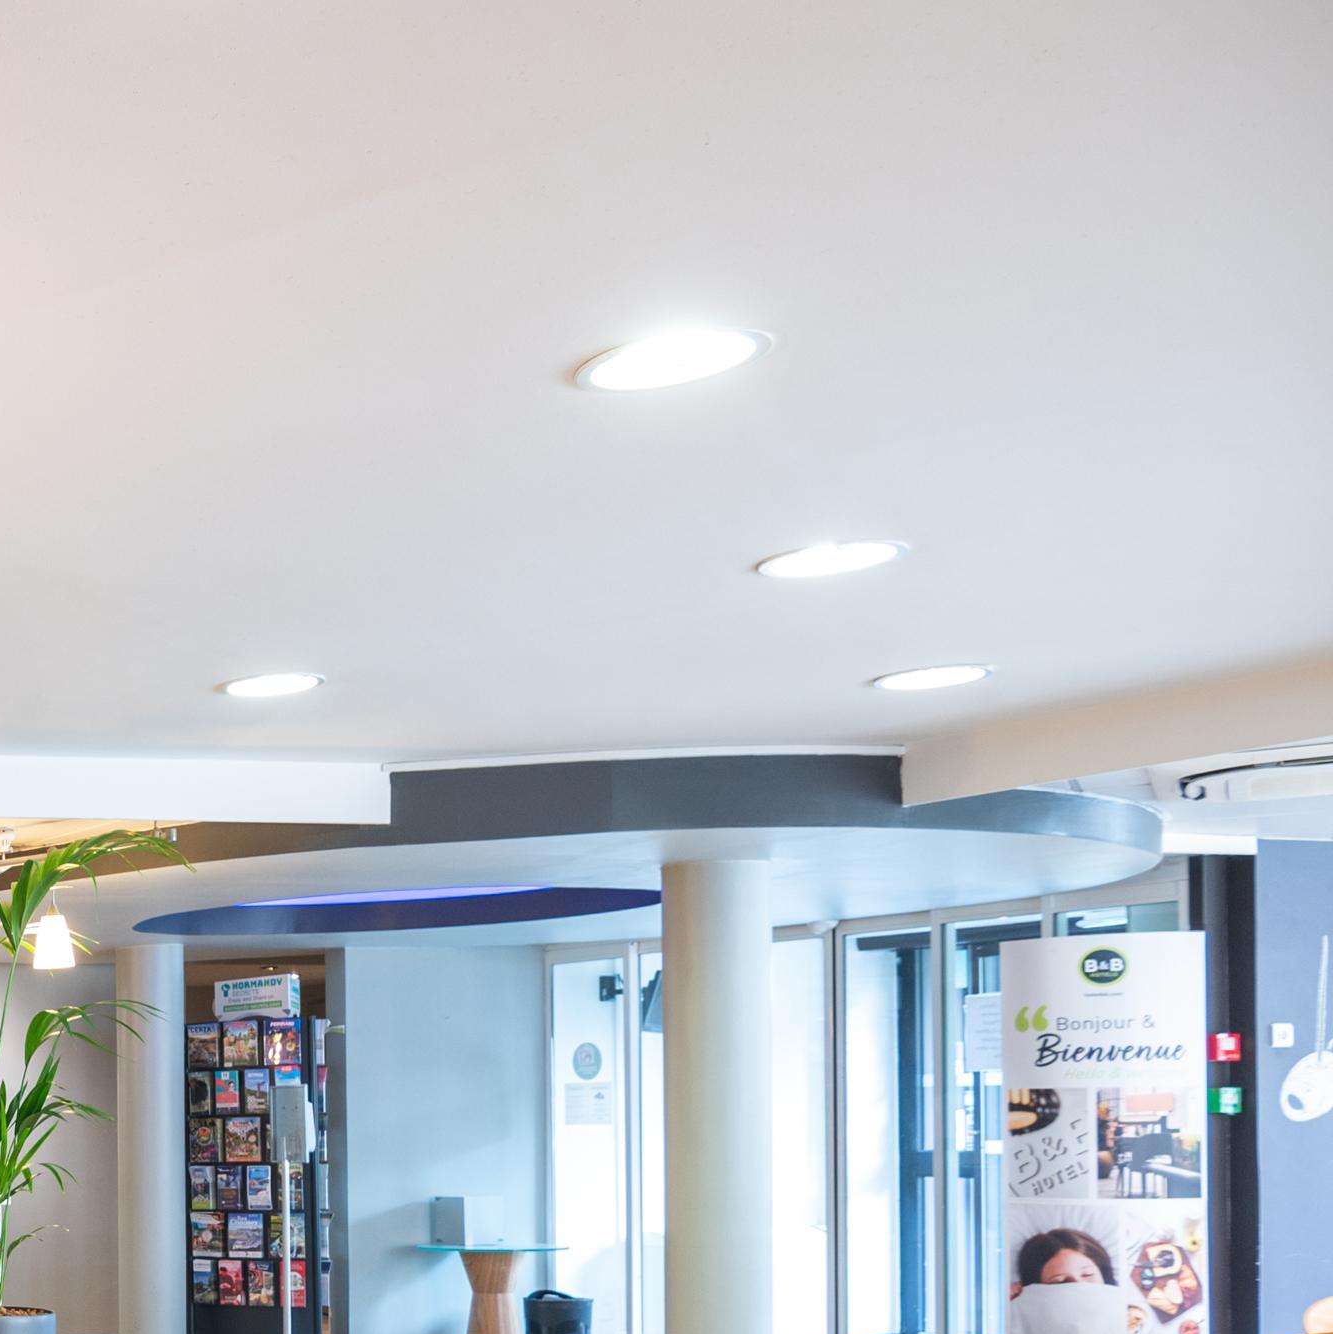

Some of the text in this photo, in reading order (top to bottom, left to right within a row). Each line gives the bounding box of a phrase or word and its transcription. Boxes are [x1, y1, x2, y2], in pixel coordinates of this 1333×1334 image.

[1084, 957, 1125, 973] B&B
[232, 978, 283, 990] NORMANDY
[1056, 1014, 1156, 1034] Bonjour &
[1035, 1033, 1186, 1068] Bienvenue
